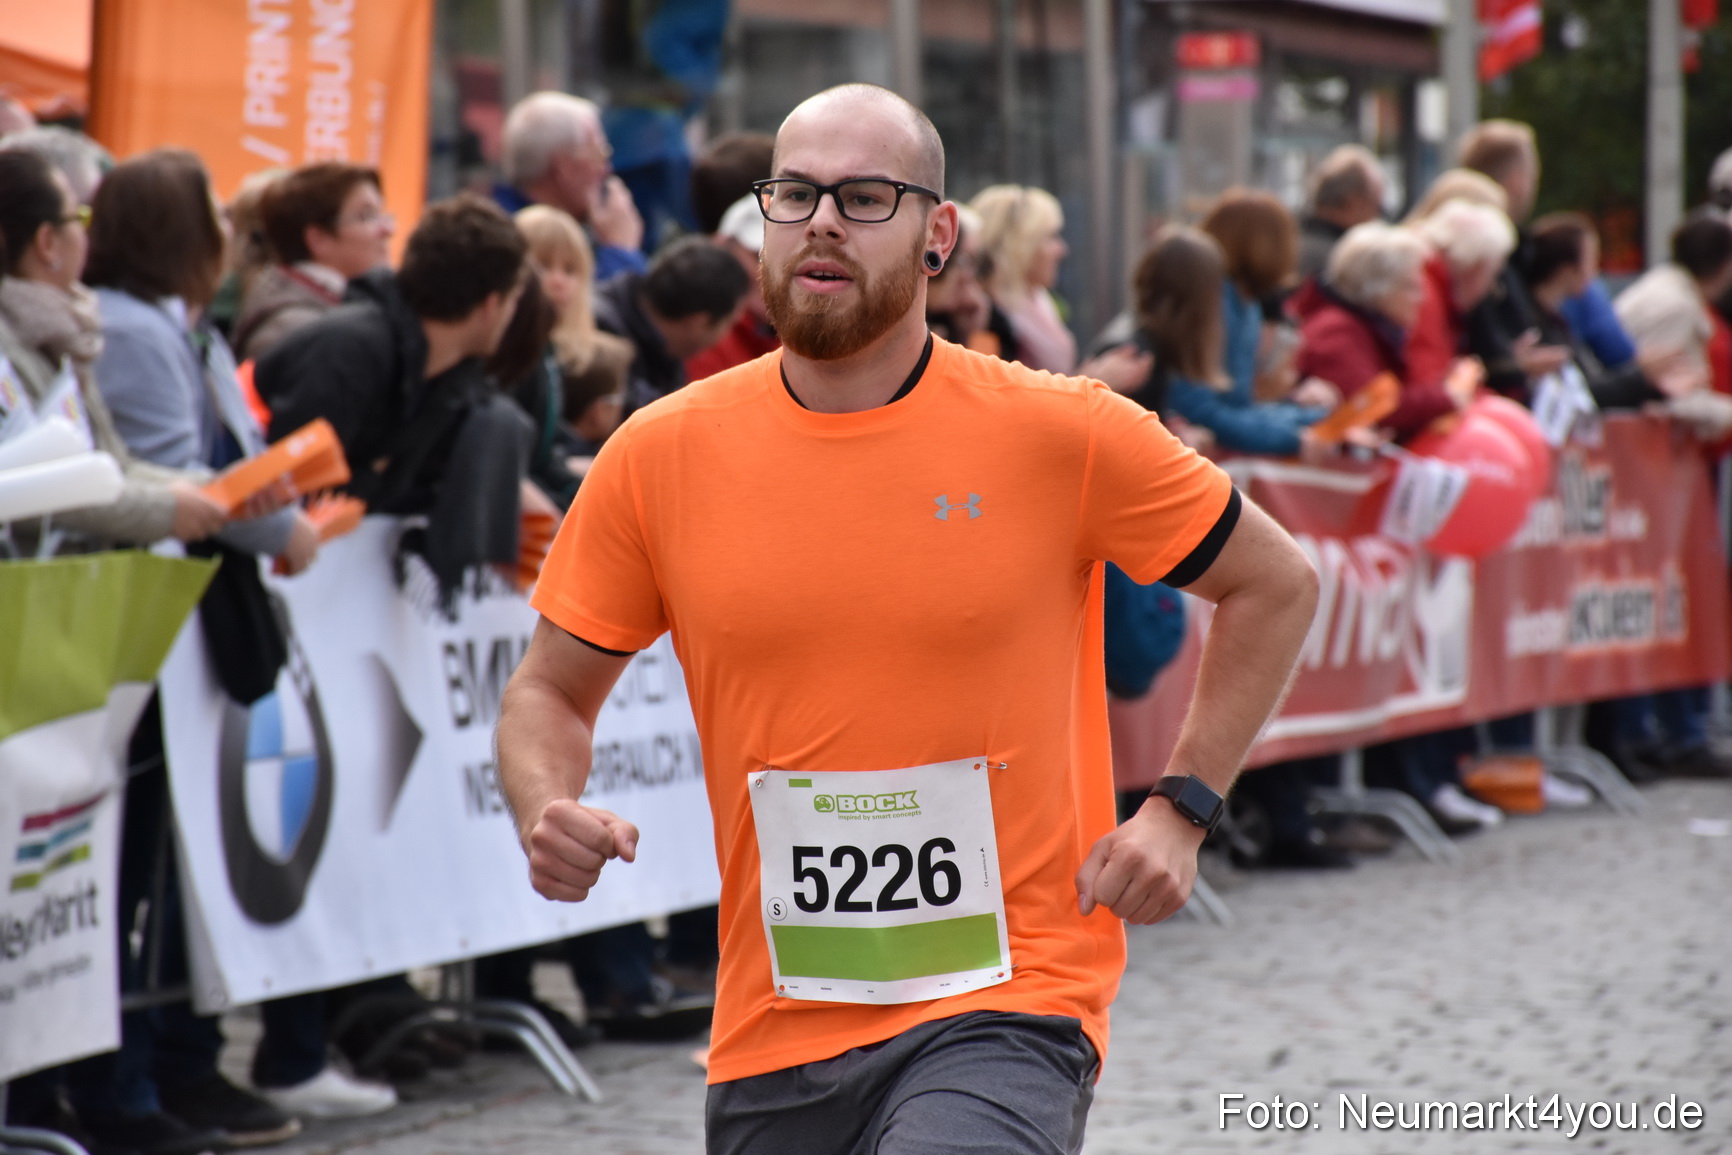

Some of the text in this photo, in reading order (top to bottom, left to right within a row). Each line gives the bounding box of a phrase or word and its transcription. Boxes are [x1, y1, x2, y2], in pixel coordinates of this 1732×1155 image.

[836, 790, 920, 813] BOCK
[838, 813, 861, 821] inspired
[893, 810, 922, 819] concepts
[792, 837, 962, 913] 5226
[773, 903, 781, 916] S
